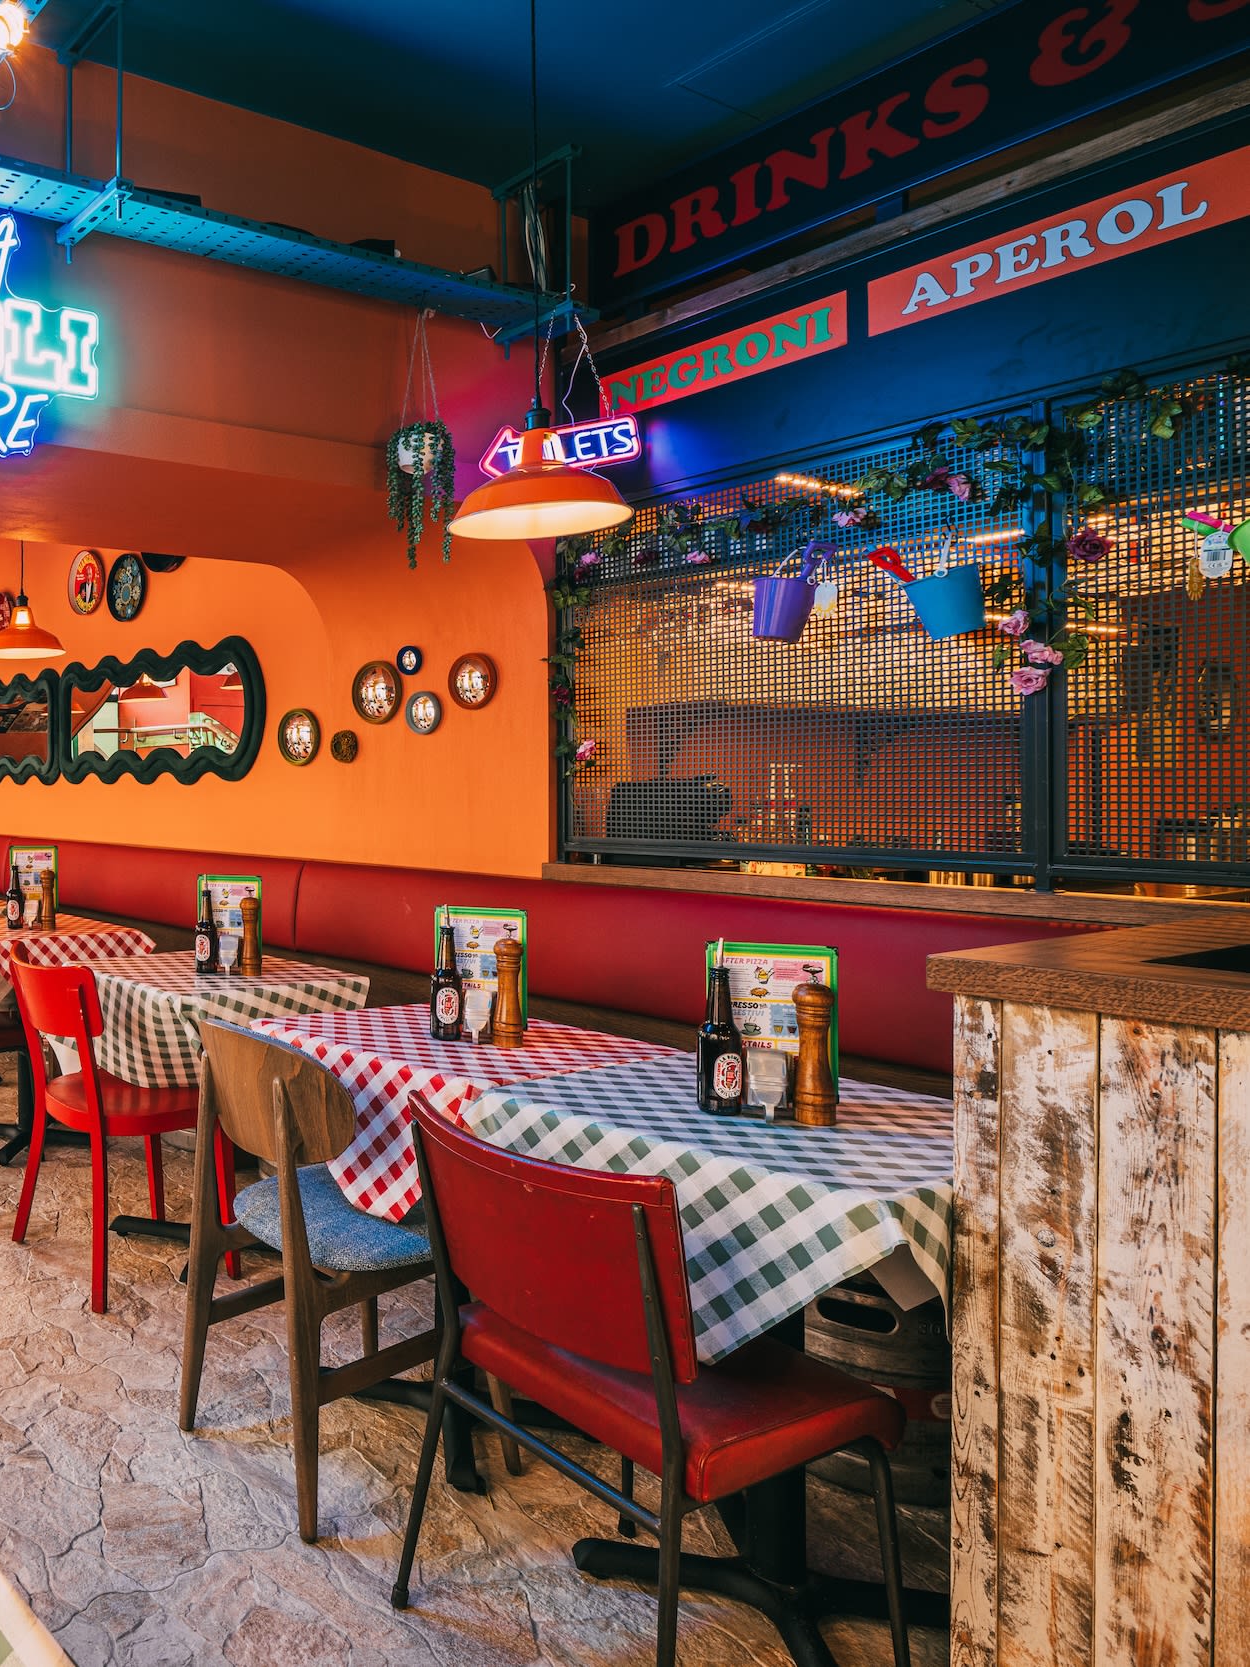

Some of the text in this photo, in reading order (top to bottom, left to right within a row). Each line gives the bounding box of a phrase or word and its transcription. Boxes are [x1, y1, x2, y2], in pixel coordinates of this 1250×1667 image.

[613, 0, 1140, 278] DRINKS &
[901, 182, 1209, 315] APEROL
[609, 306, 834, 411] NEGRONI
[498, 423, 634, 468] TLETS
